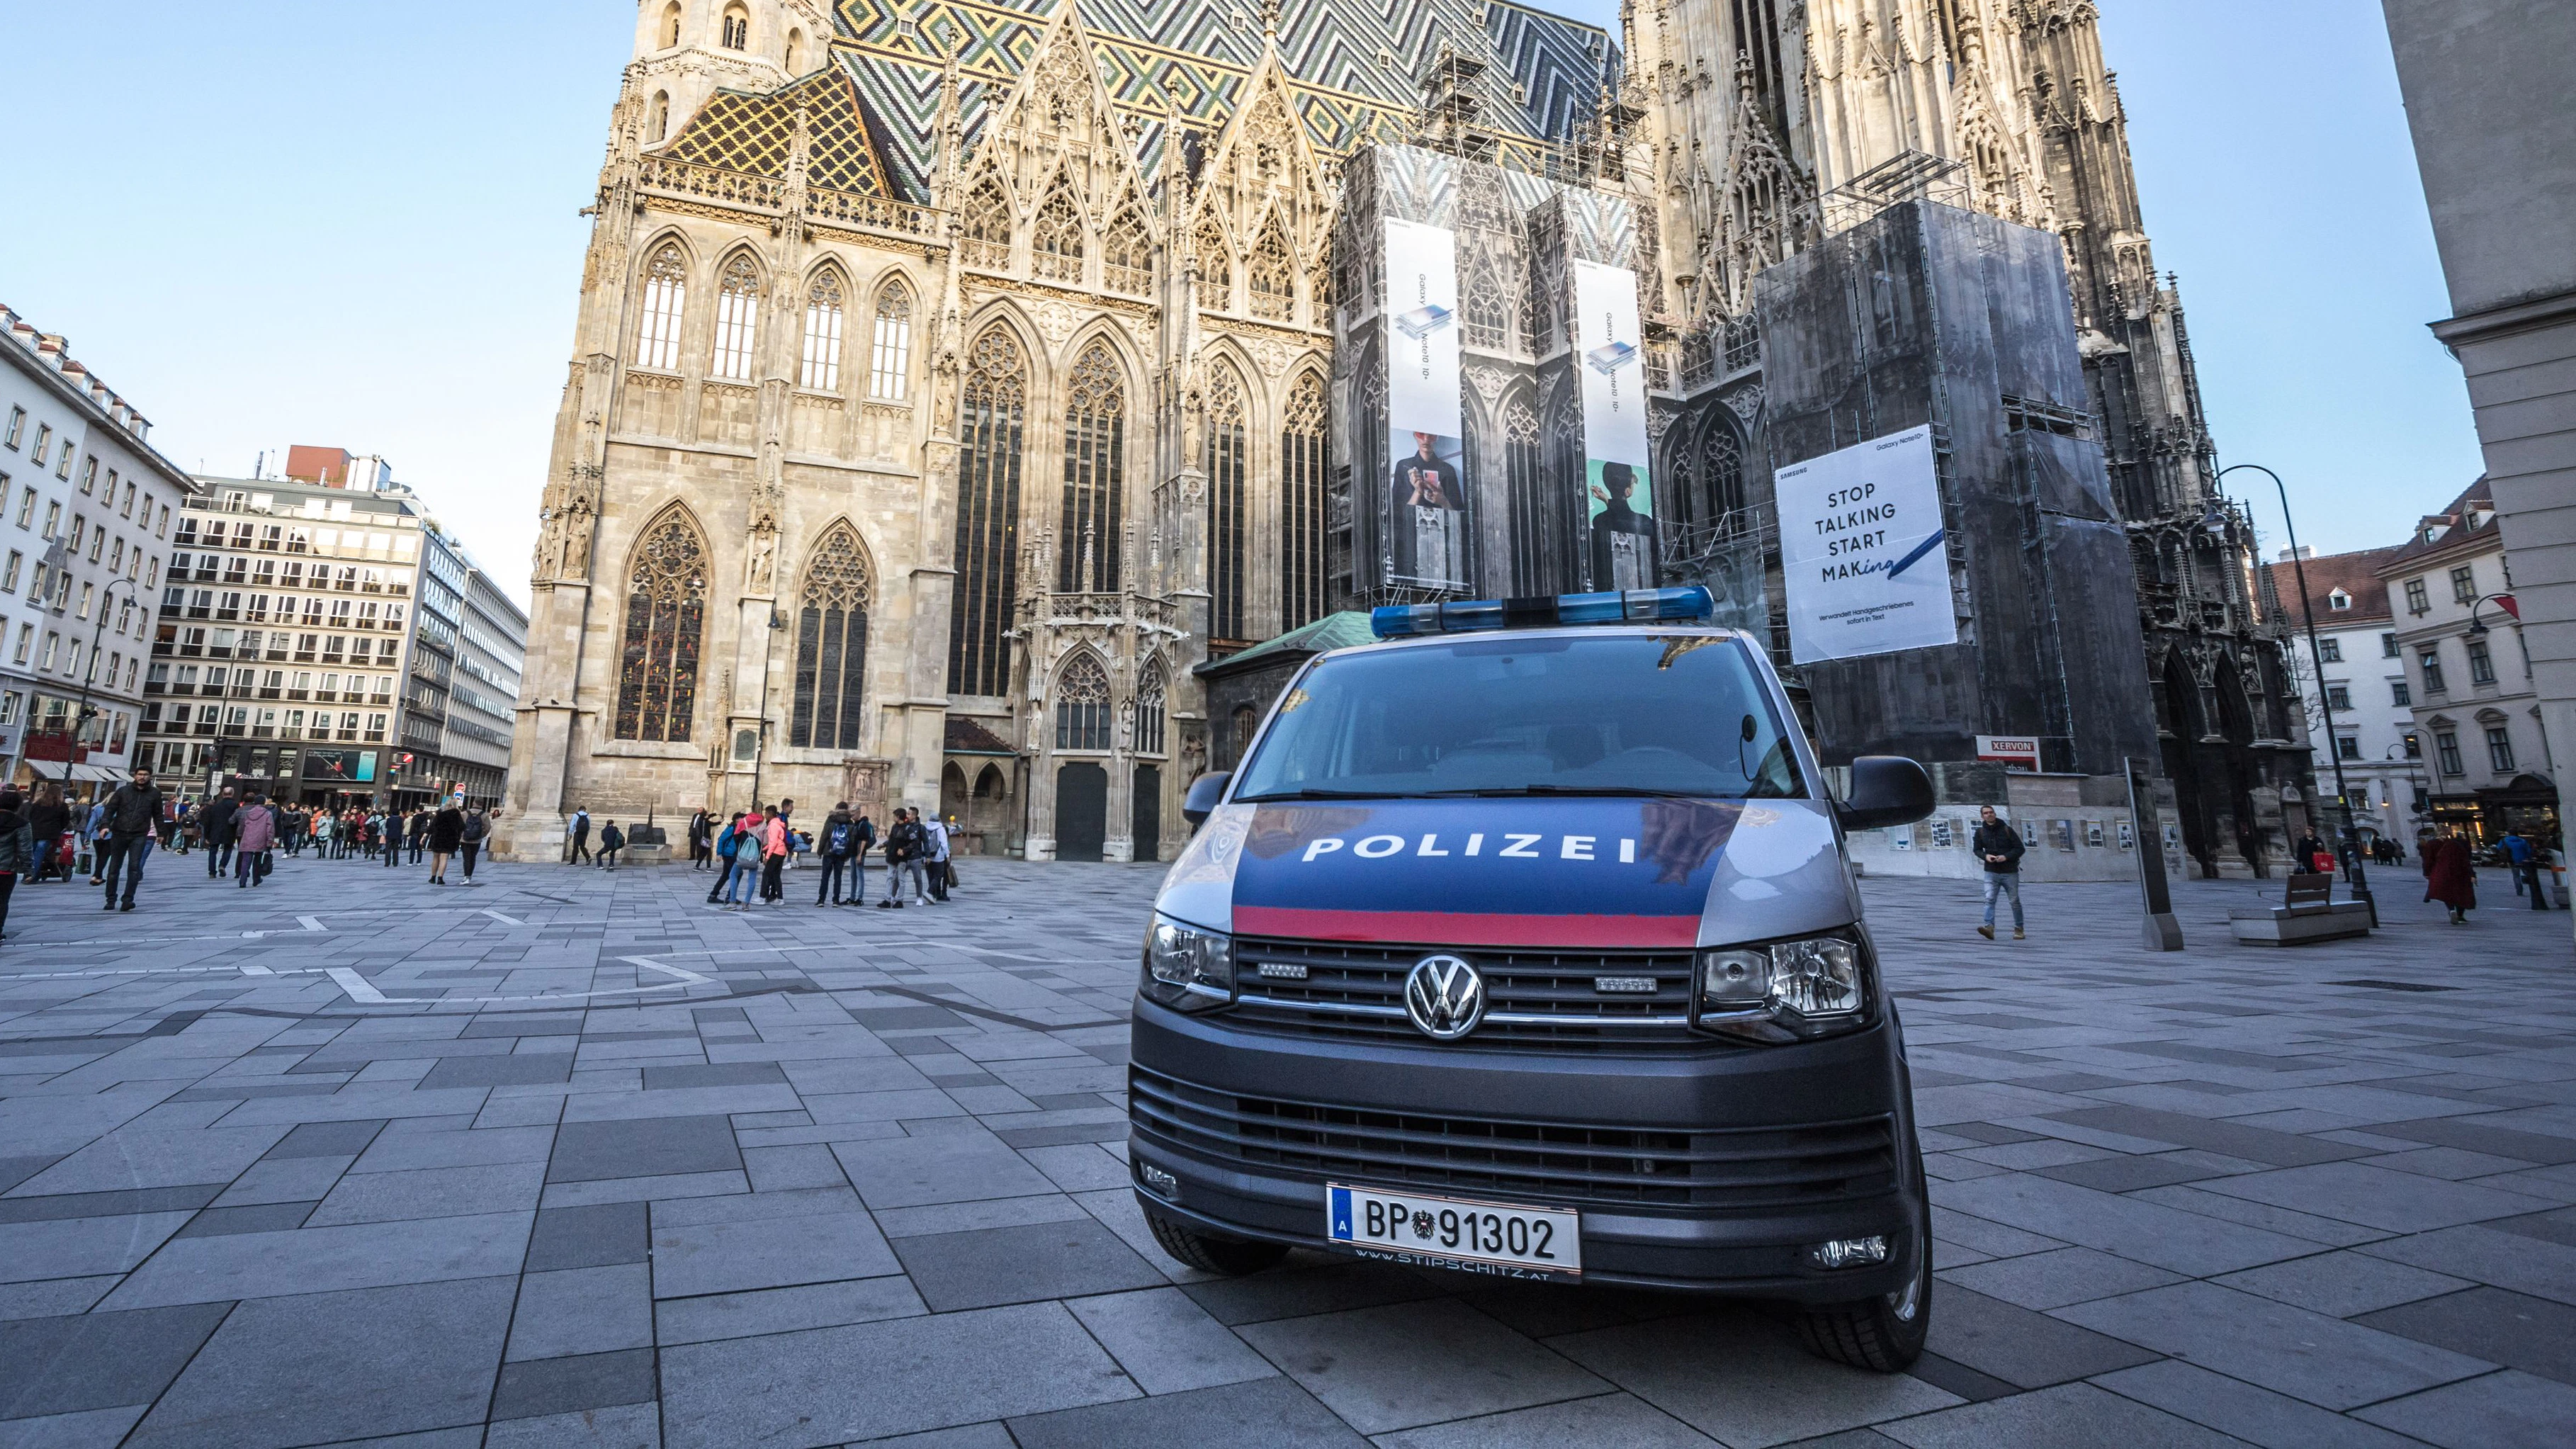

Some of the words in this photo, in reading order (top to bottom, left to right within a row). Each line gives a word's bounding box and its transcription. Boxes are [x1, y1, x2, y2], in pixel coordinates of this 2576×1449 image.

[1877, 441, 1899, 451] Galaxy
[1899, 433, 1923, 444] Note10+
[1780, 467, 1807, 480] SAMSUNG
[1828, 483, 1875, 507] STOP
[1815, 503, 1895, 535] TALKING
[1829, 530, 1885, 556] START
[1819, 610, 1851, 621] Verwandelt
[1853, 601, 1914, 615] Handgeschriebenes
[1302, 833, 1635, 863] POLIZEI
[1338, 1220, 1347, 1232] A
[1366, 1200, 1408, 1240] BP
[1439, 1209, 1555, 1259] 91302
